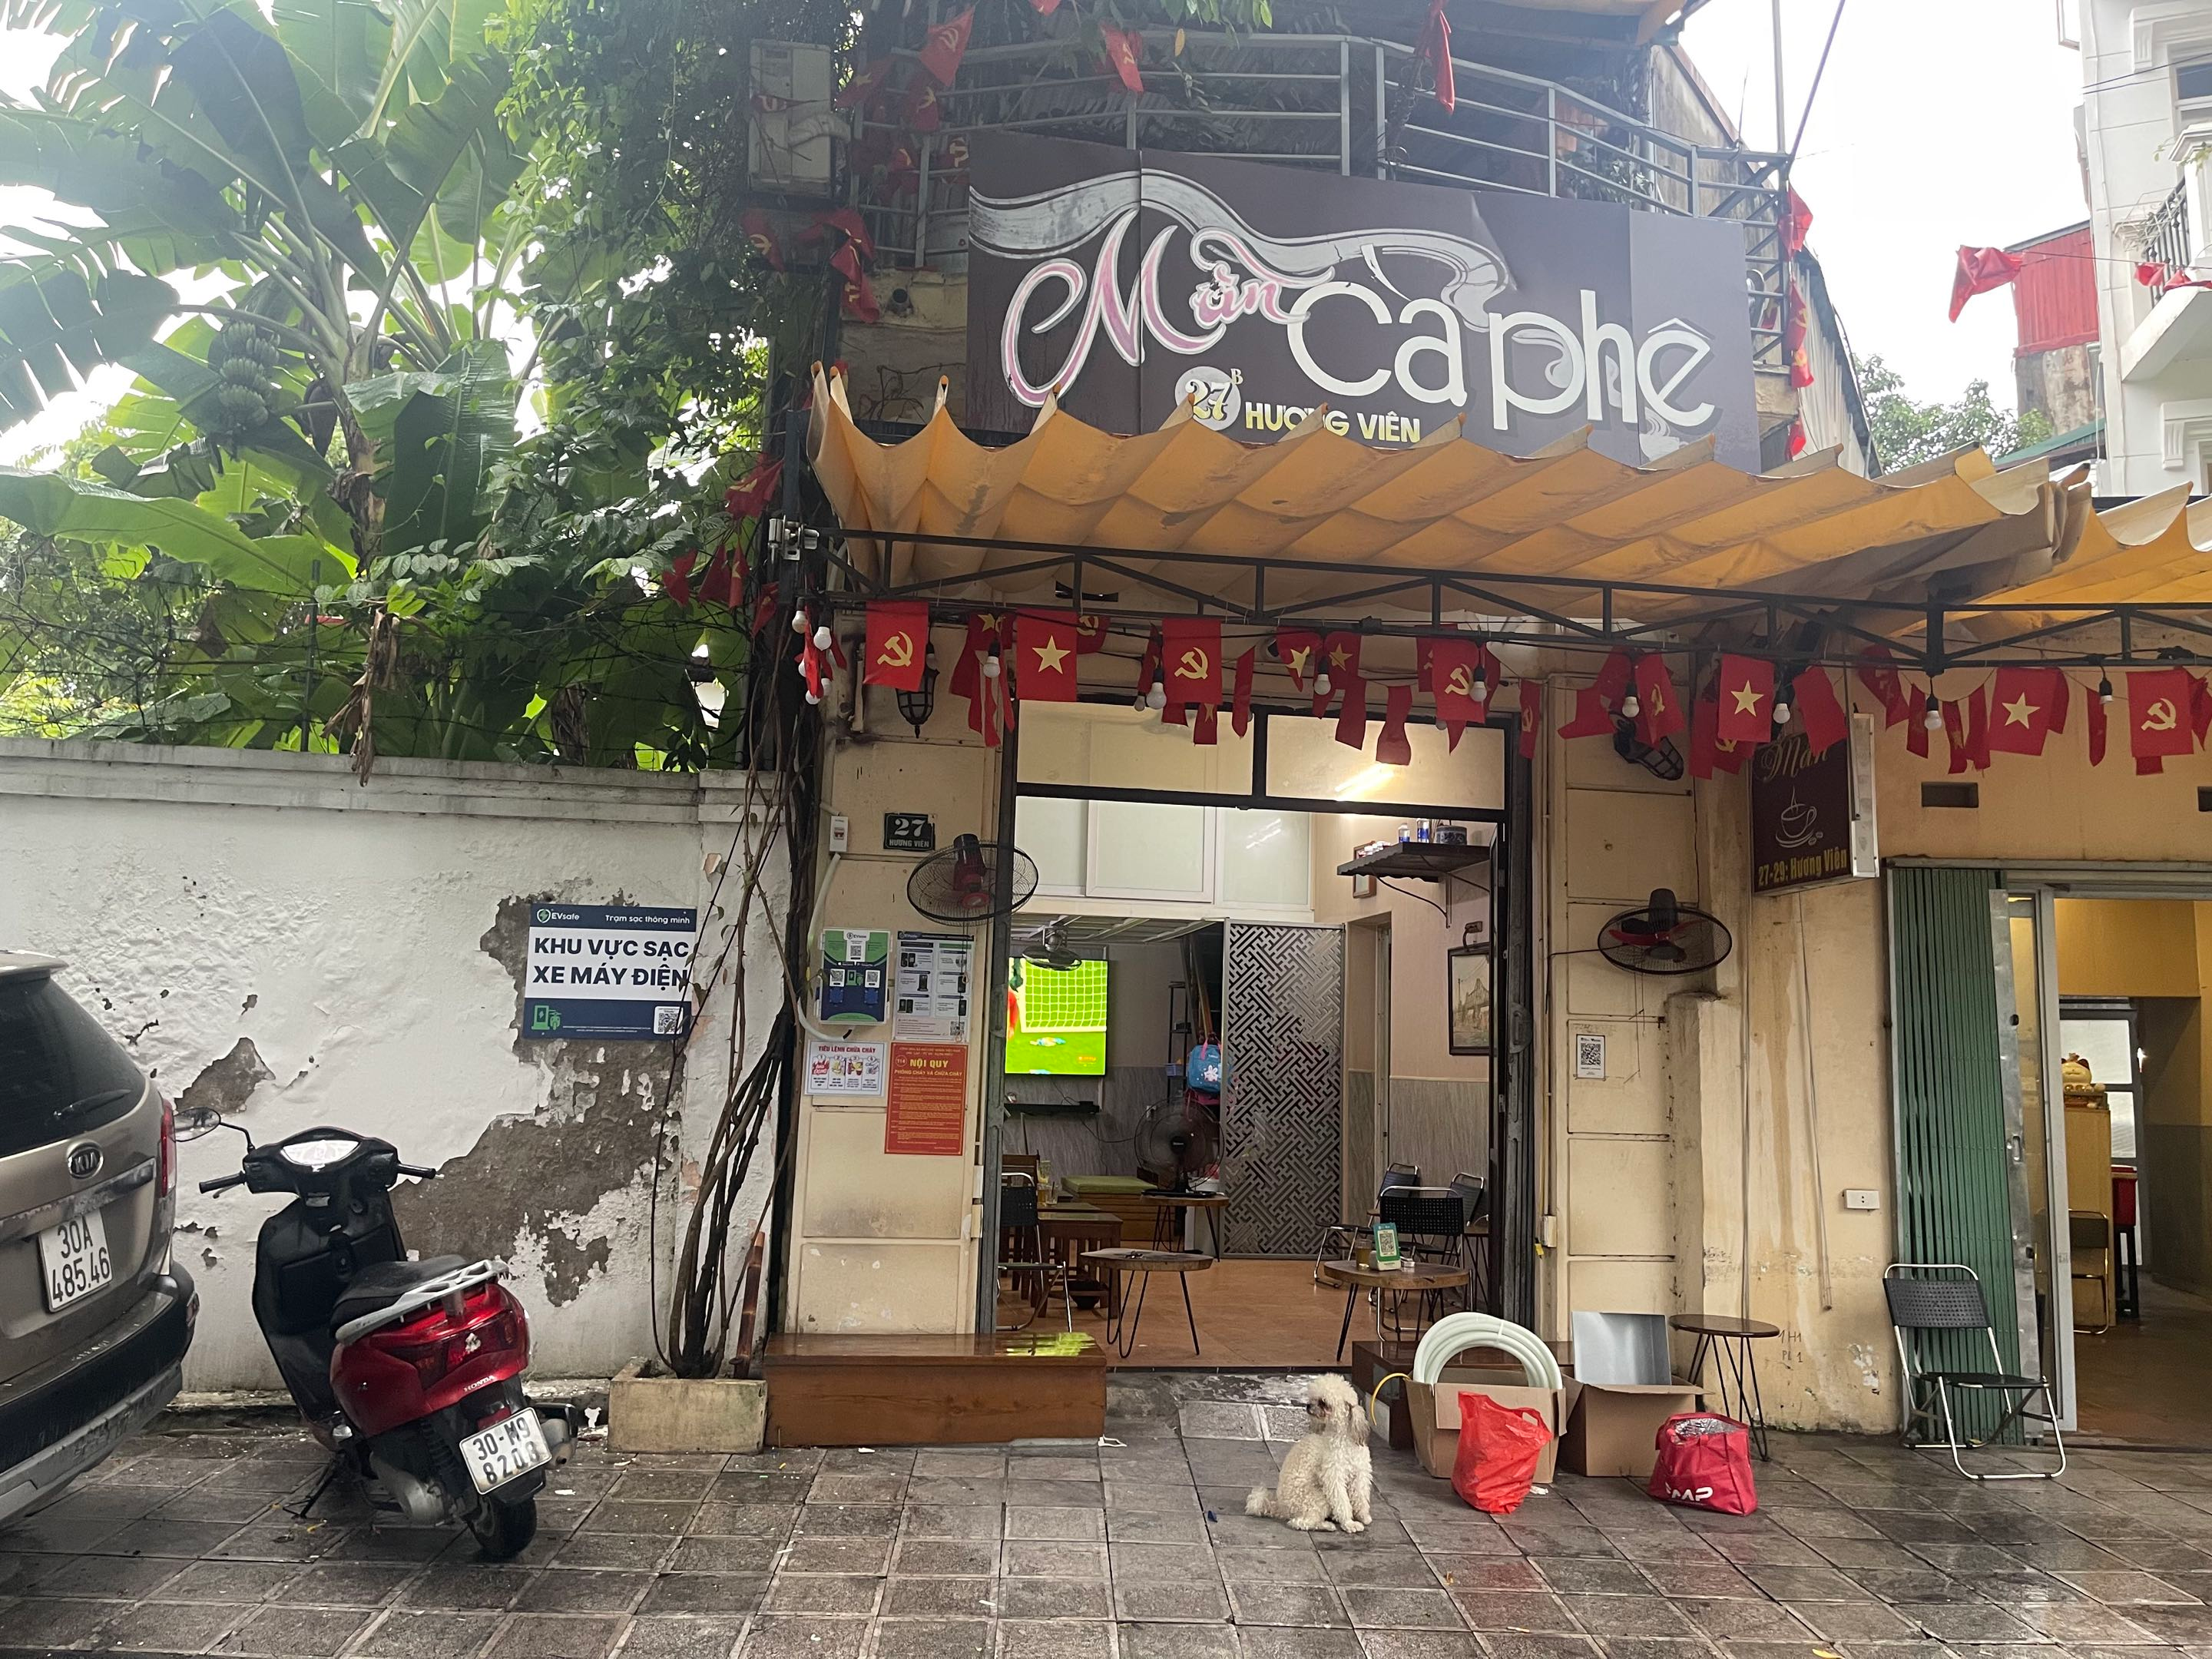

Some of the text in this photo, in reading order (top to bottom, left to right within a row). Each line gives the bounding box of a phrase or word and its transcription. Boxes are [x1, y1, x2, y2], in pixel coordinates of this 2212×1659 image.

[1488, 289, 1715, 430] phê
[1245, 402, 1420, 443] HƯƠG VIÊN
[894, 818, 926, 836] 27
[1823, 846, 1848, 873] Viên
[551, 912, 580, 921] EVsafe
[605, 914, 690, 925] Trạm sạc thông minh
[535, 937, 689, 962] KHU VỰC SẠC
[532, 962, 688, 992] XE MÁY ĐIỆN
[909, 1058, 949, 1069] NỘI QUY
[75, 1151, 98, 1174] KIA
[58, 1214, 93, 1259] 30A
[52, 1247, 111, 1303] 485.46
[463, 1375, 495, 1392] HONDA
[472, 1416, 531, 1461] 30-M9
